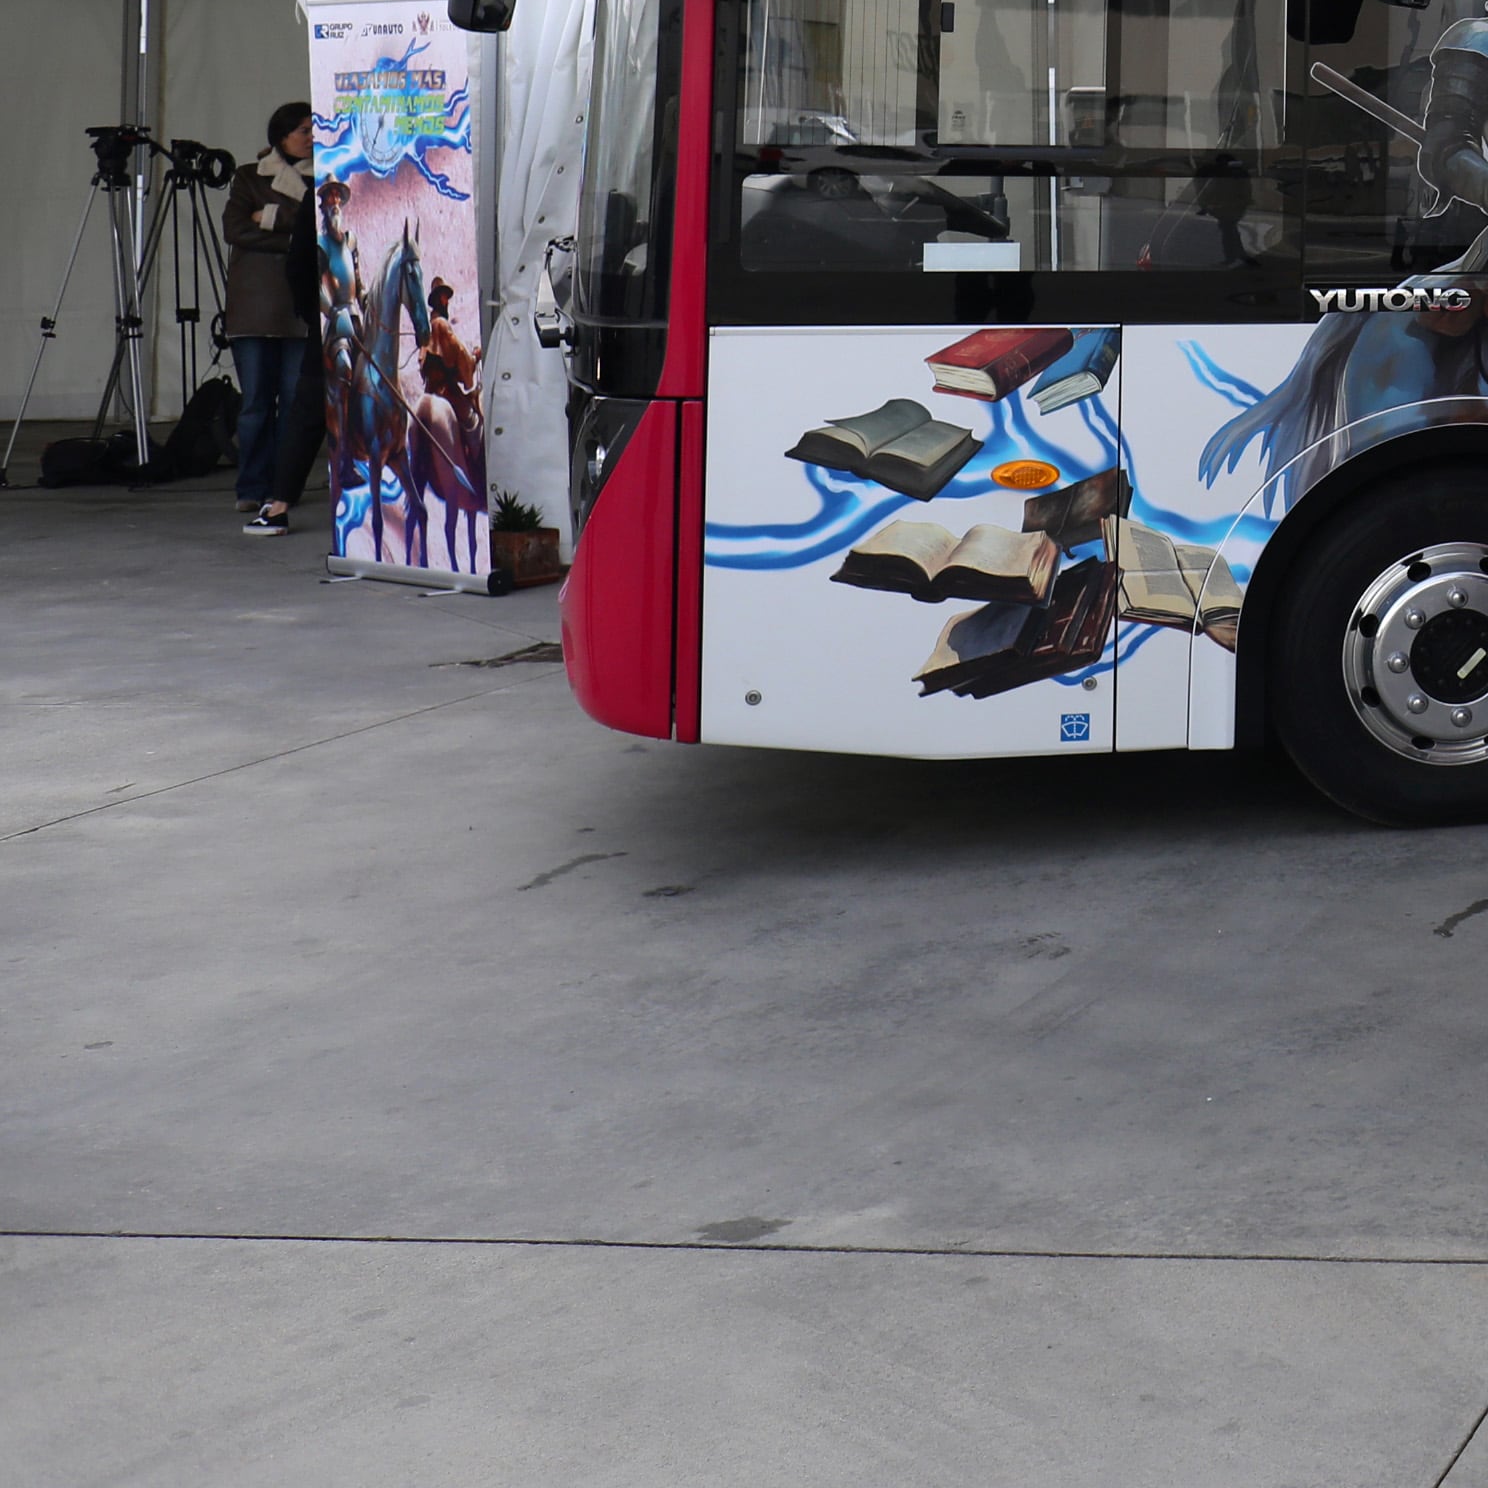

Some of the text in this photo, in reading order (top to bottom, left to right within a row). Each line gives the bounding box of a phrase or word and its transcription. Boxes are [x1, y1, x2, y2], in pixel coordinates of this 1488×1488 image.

[373, 23, 404, 36] UNAUTO
[335, 71, 407, 90] VIAJAMOS
[1309, 287, 1472, 313] YUTONG
